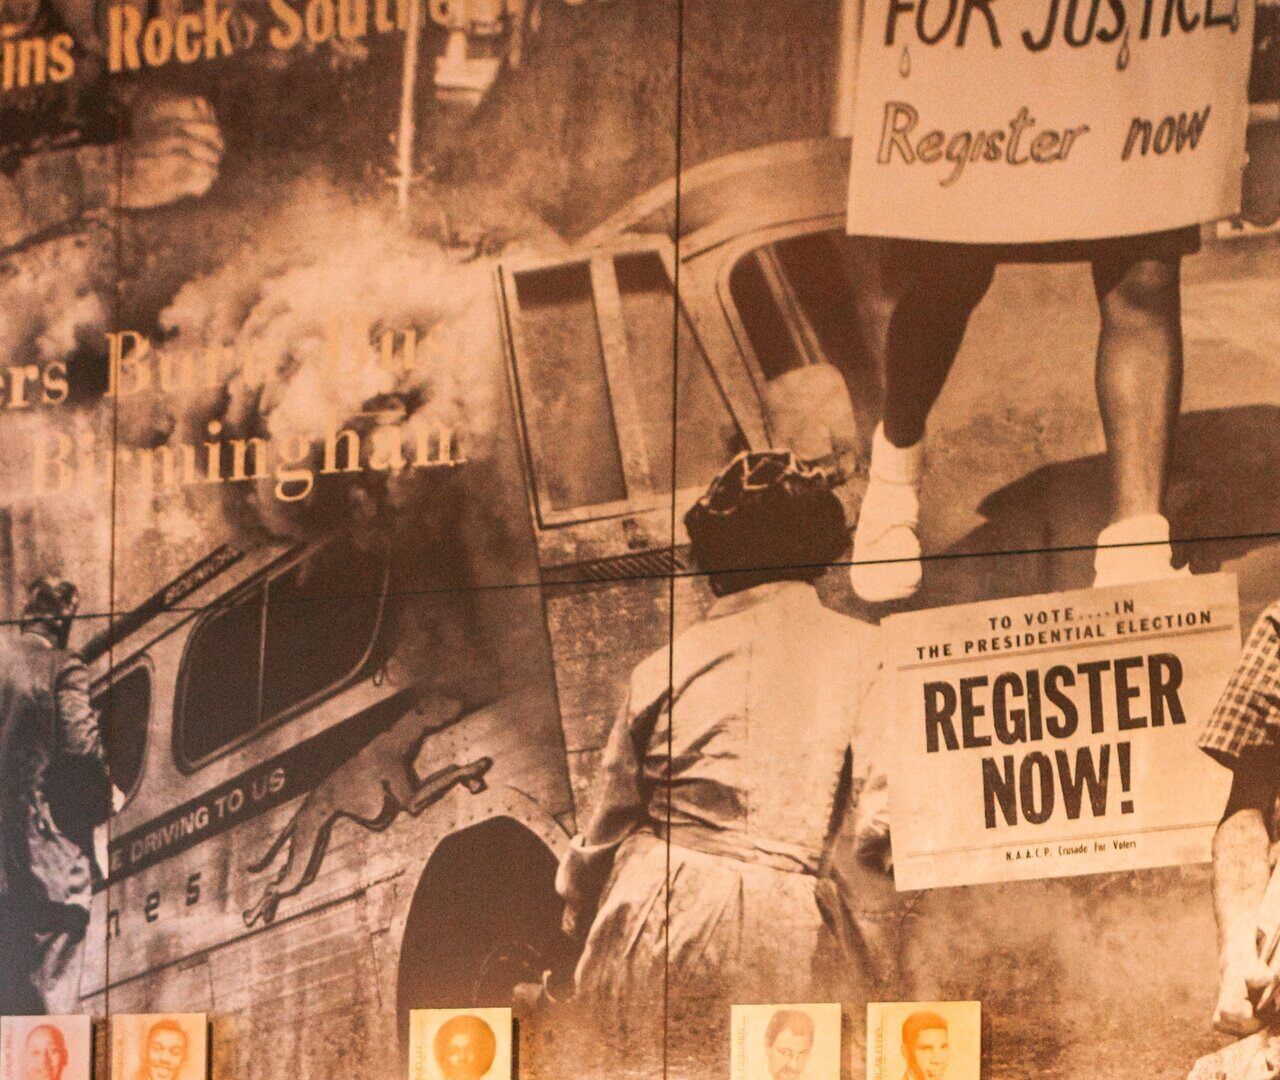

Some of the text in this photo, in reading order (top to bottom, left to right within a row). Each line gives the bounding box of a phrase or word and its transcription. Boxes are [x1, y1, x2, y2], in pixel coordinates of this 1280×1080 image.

[107, 0, 235, 73] Rock
[884, 0, 1003, 49] FOR
[876, 100, 1212, 189] Register now
[31, 405, 469, 503] Birmingham
[916, 610, 1213, 662] THE PRESIDENTIAL ELECTION
[988, 615, 1013, 631] TO
[922, 652, 1187, 754] REGISTER
[130, 805, 210, 862] DRIVING
[215, 787, 245, 819] TO
[252, 767, 287, 800] US
[981, 741, 1135, 830] NOW!
